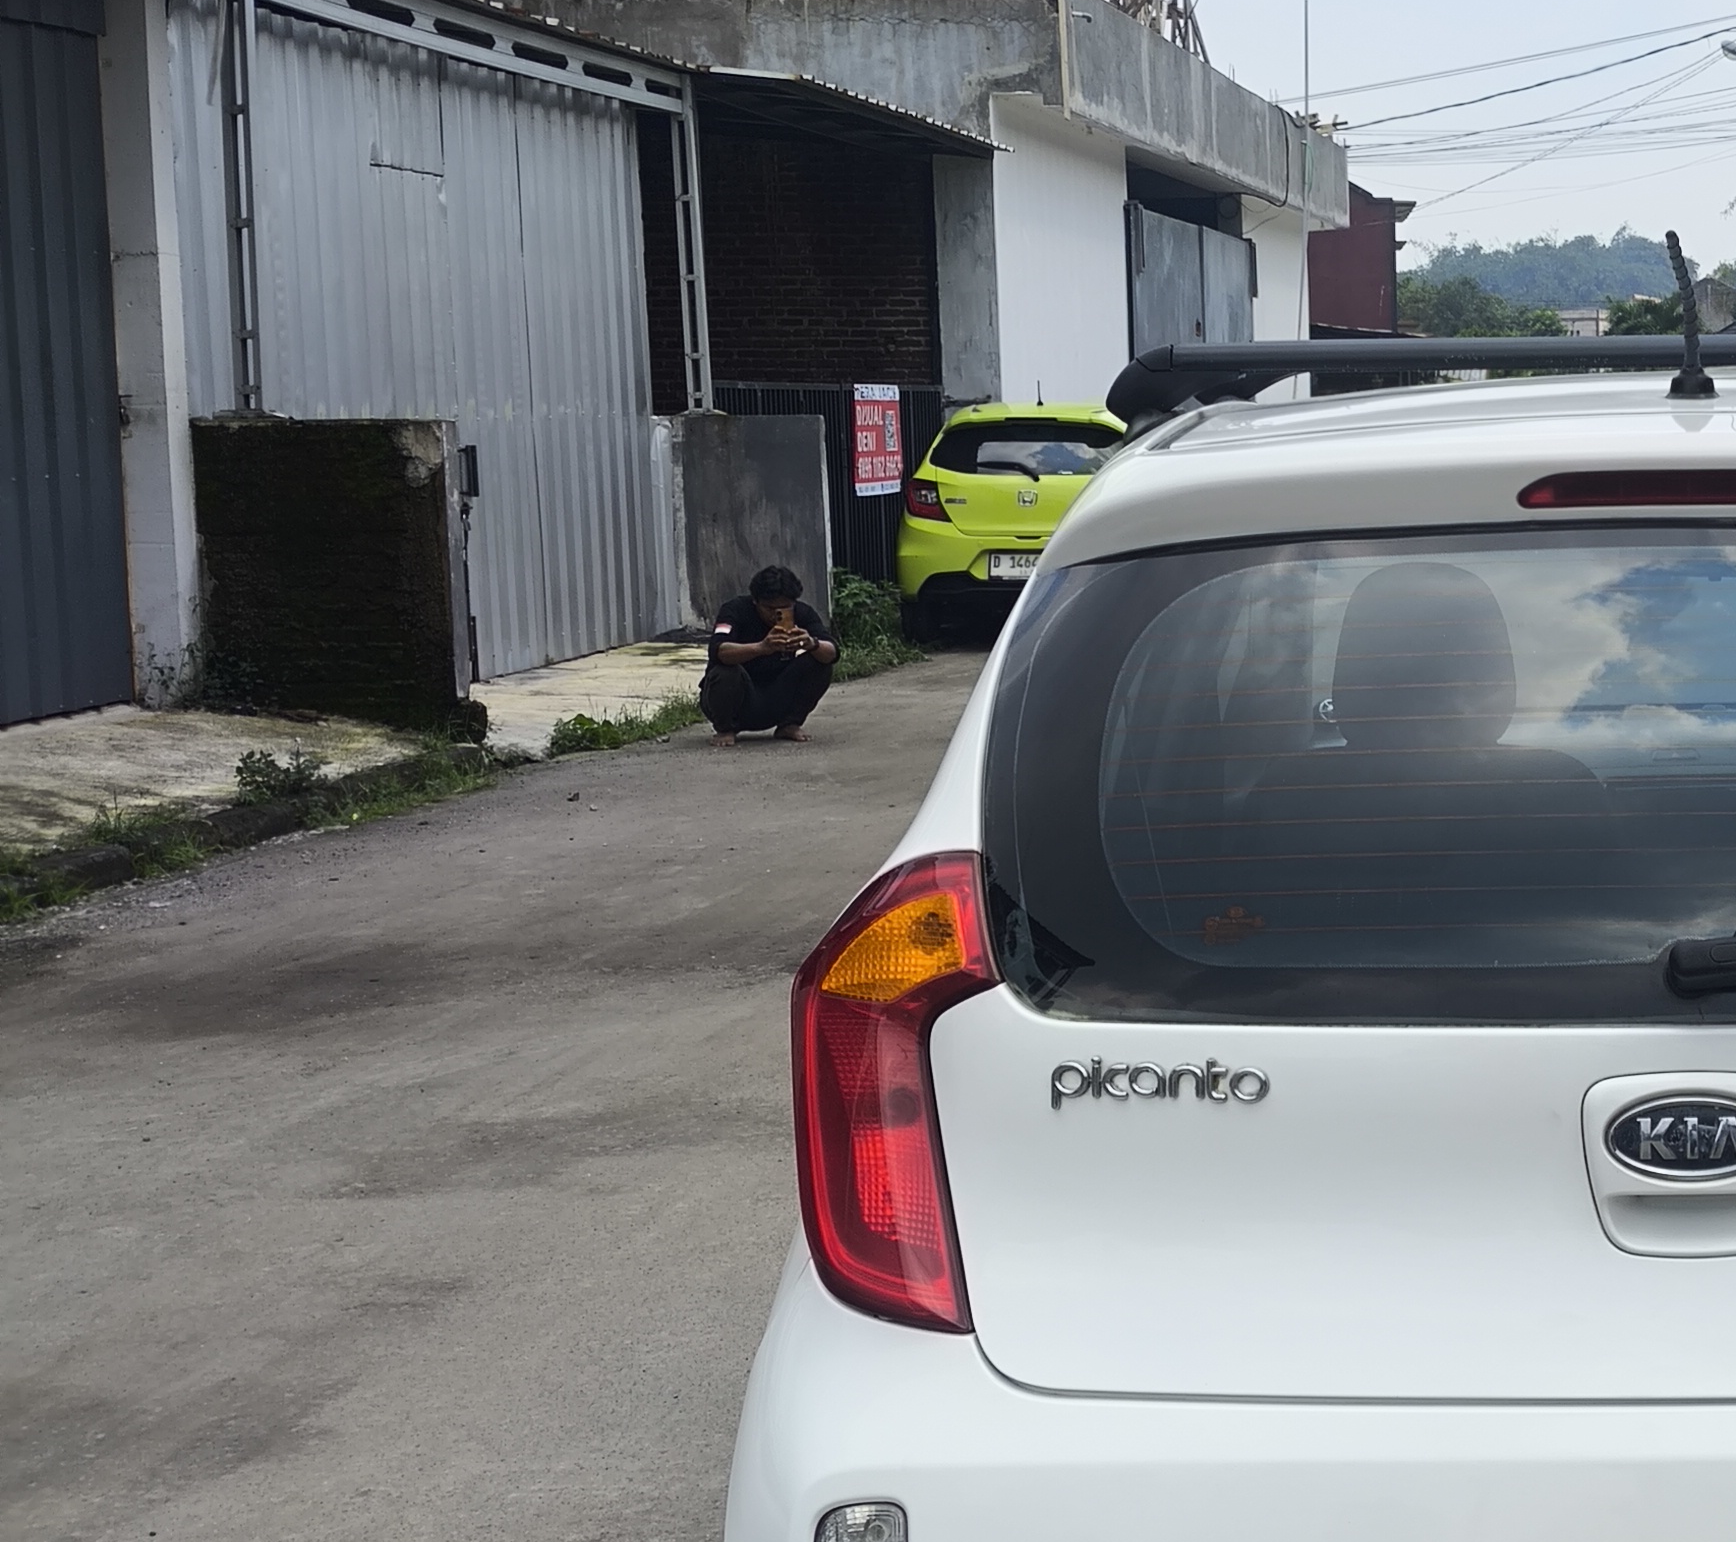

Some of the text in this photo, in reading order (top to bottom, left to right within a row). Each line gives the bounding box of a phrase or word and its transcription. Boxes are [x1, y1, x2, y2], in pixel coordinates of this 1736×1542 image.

[856, 405, 884, 426] DIJUAL
[993, 555, 1001, 568] D
[1051, 1056, 1271, 1110] picanto
